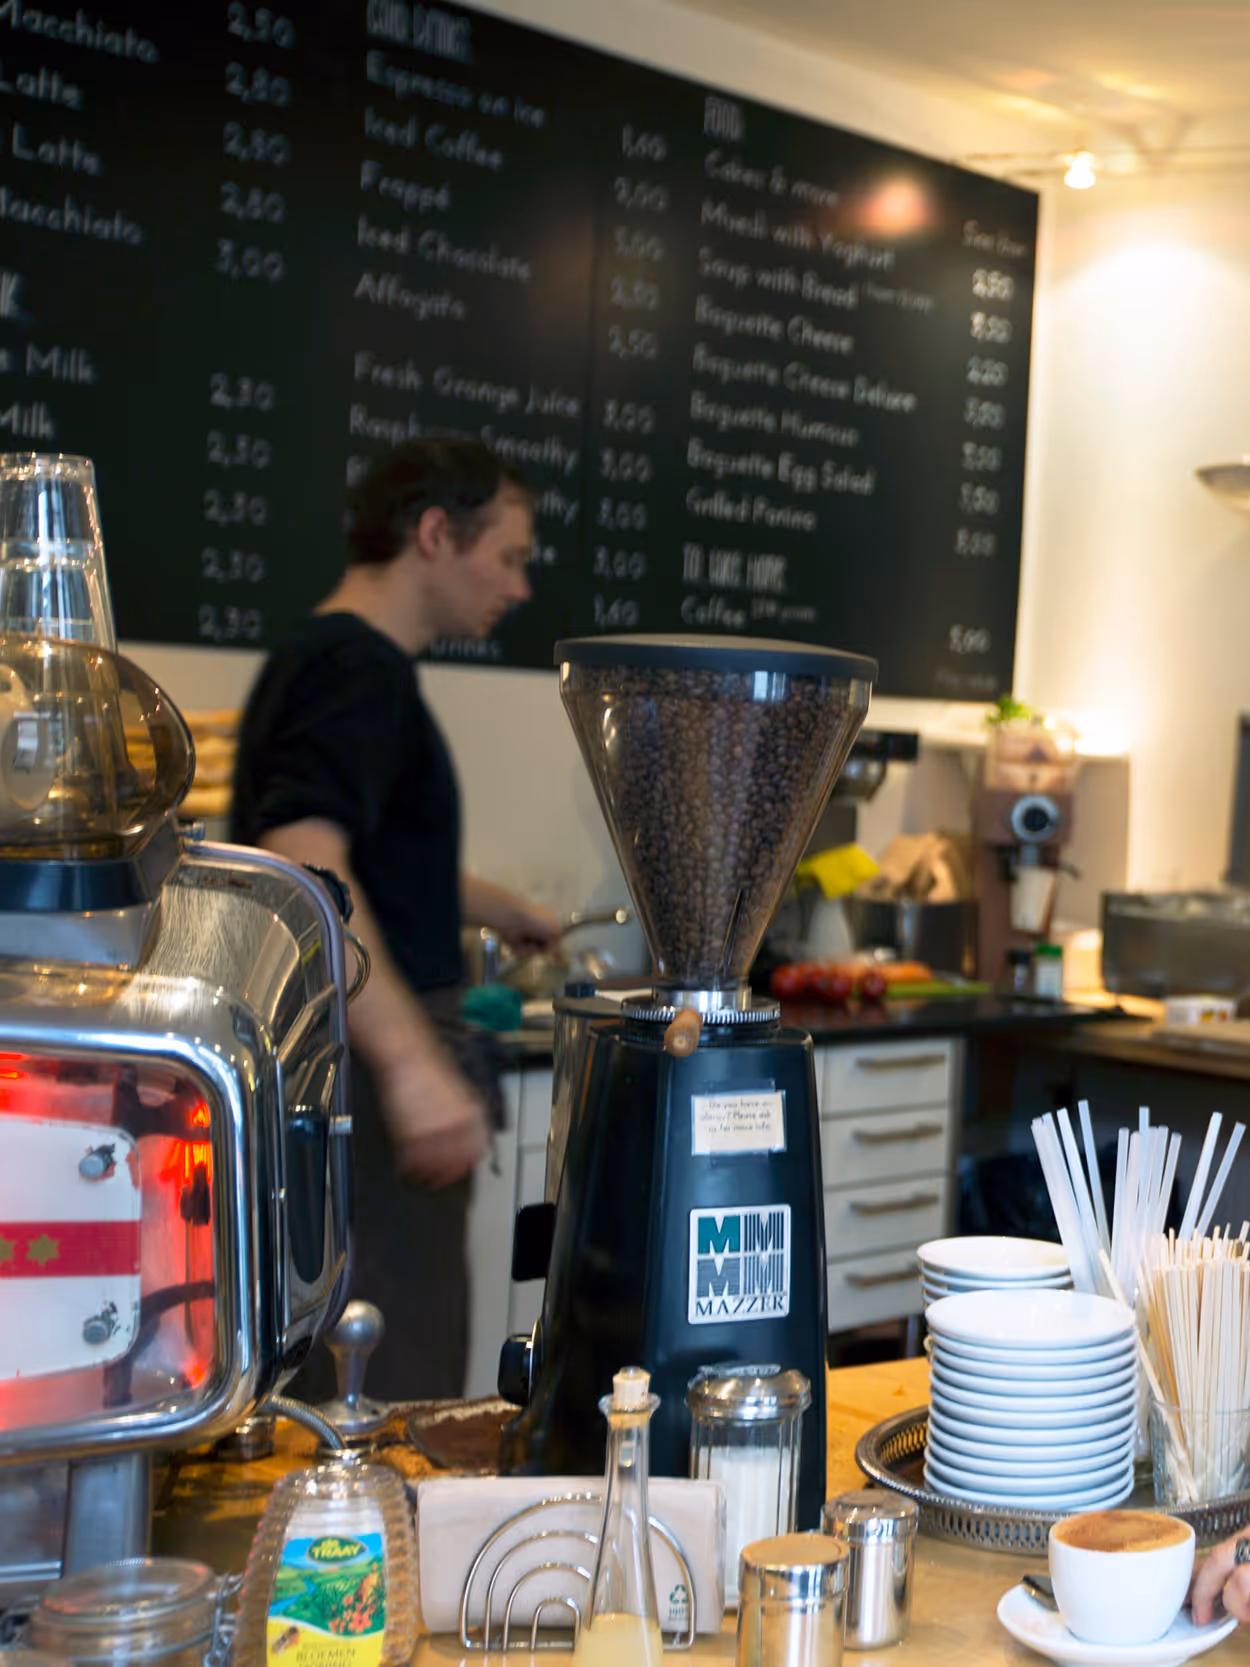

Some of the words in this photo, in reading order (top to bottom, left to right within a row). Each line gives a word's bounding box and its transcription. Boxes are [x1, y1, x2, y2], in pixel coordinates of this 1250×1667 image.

[424, 123, 504, 171] Coffee
[680, 595, 746, 629] Coffee
[695, 1295, 784, 1317] MAZZER
